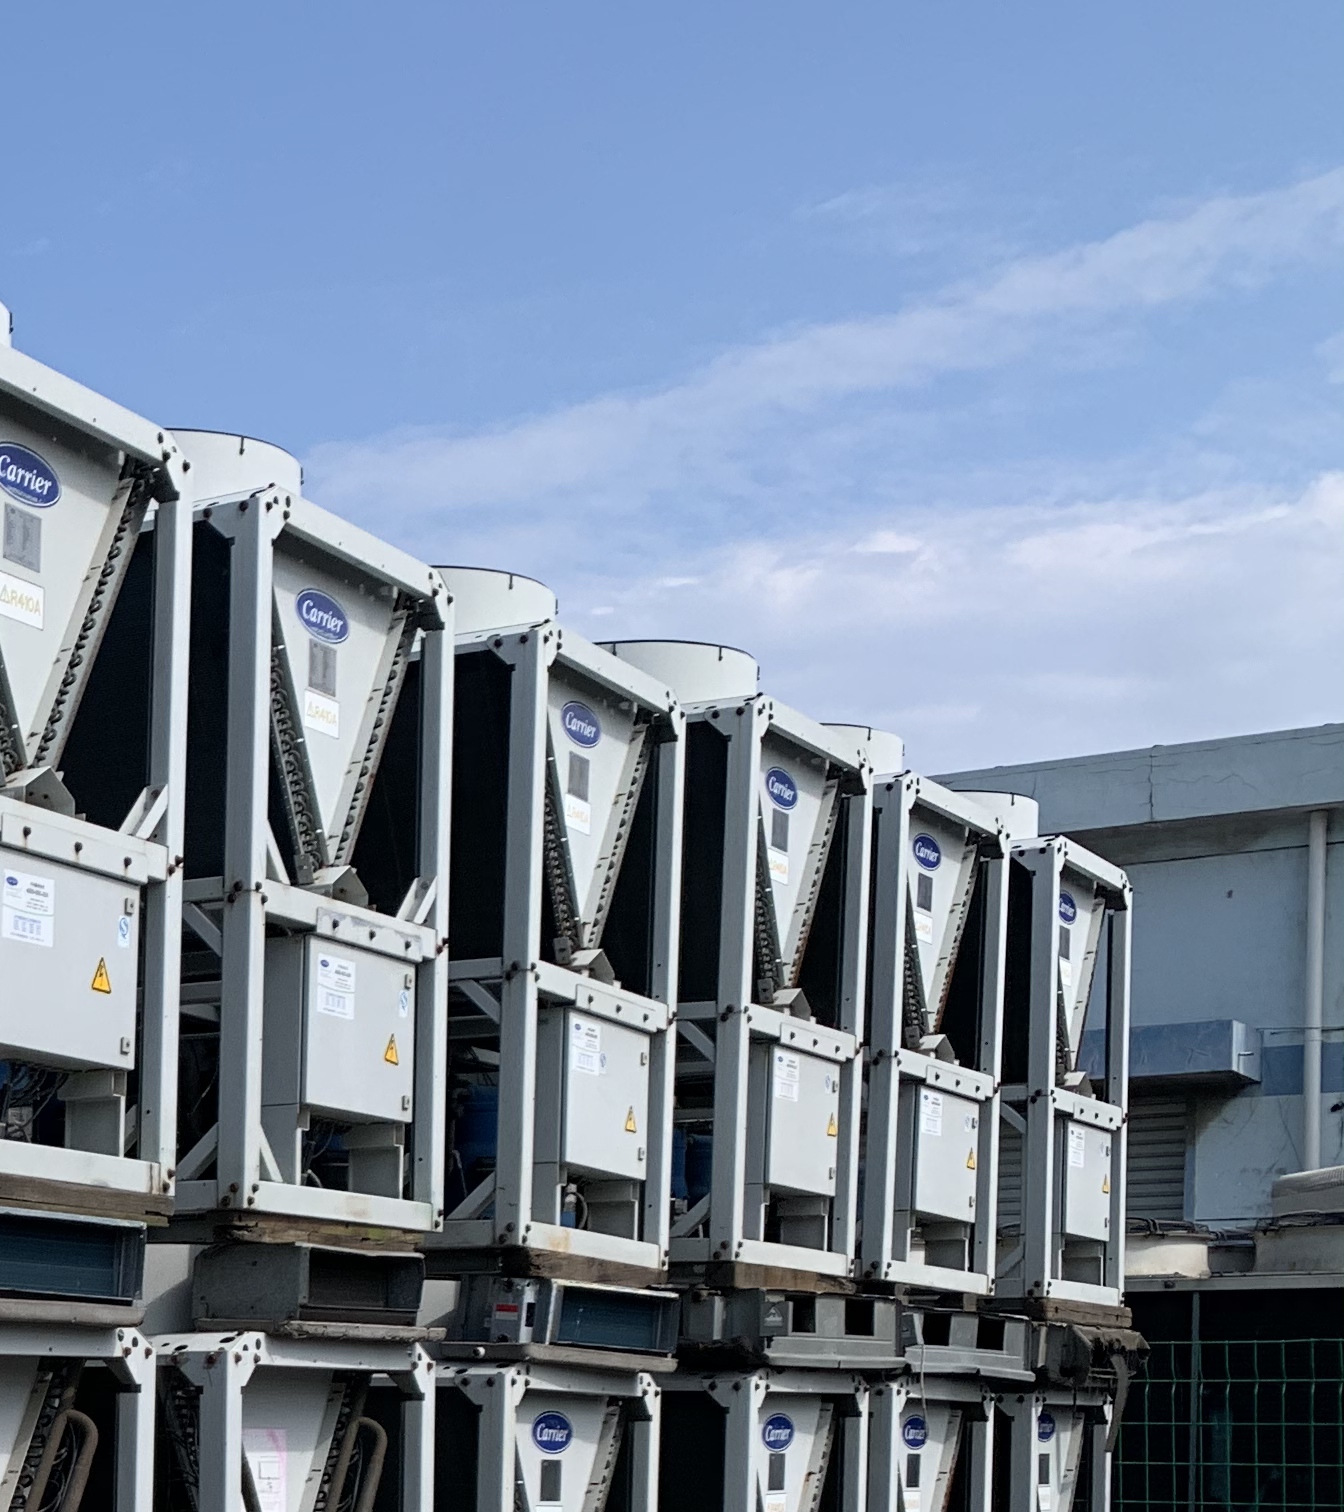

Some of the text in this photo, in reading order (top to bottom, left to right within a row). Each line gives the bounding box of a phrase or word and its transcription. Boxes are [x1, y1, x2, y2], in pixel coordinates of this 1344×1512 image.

[302, 599, 344, 634] Carrier
[565, 711, 597, 738] Carrier
[768, 776, 795, 801] Carrier
[915, 841, 939, 863] Carrier
[536, 1422, 569, 1442] Carrier
[765, 1425, 792, 1442] Carrier
